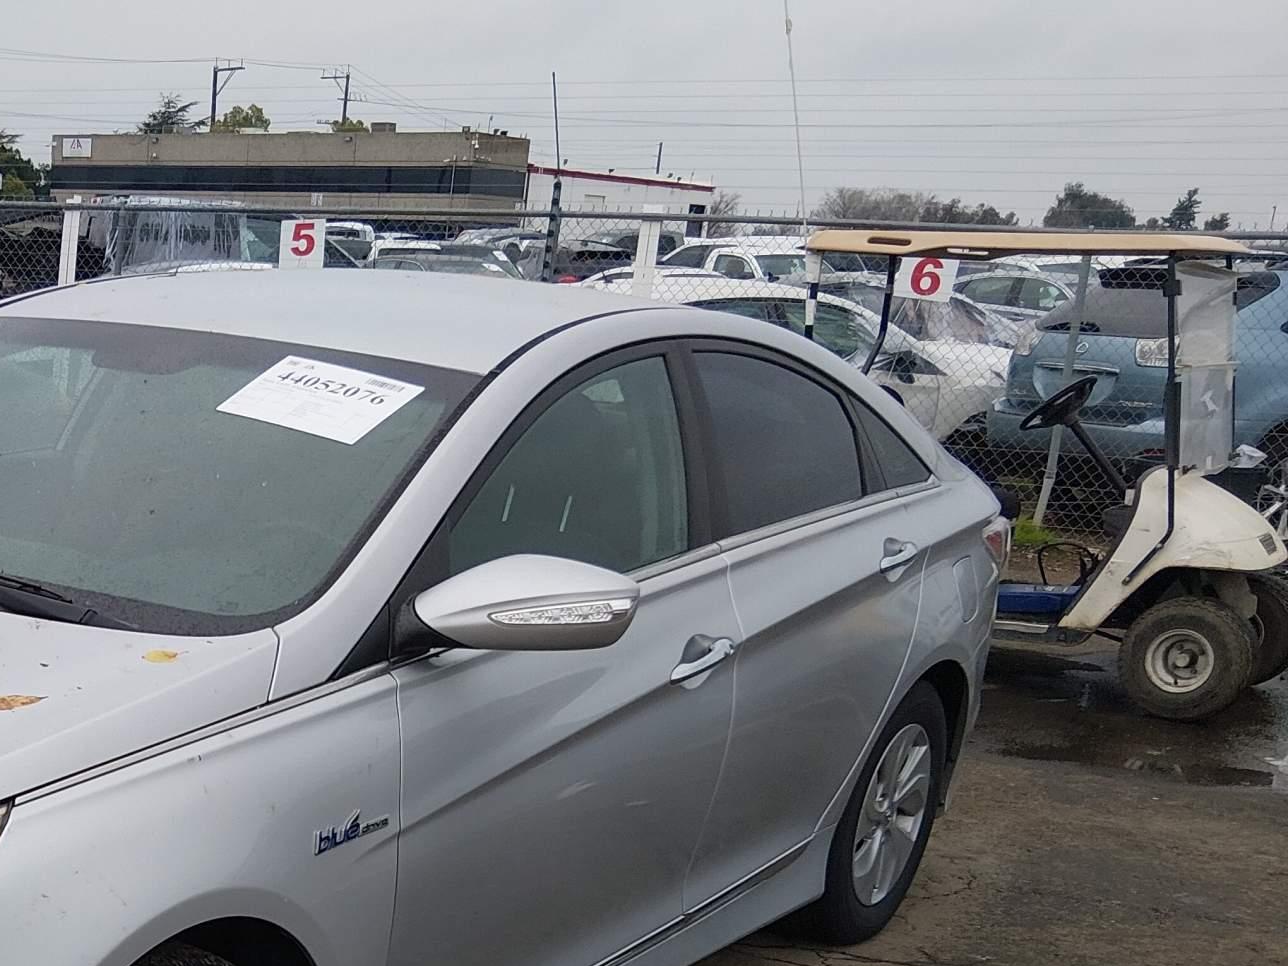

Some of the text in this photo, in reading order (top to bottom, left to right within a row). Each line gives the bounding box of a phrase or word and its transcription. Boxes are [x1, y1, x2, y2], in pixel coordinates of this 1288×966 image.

[290, 223, 315, 256] 5
[911, 257, 943, 296] 6
[278, 371, 385, 406] 44052076
[313, 809, 360, 856] blue
